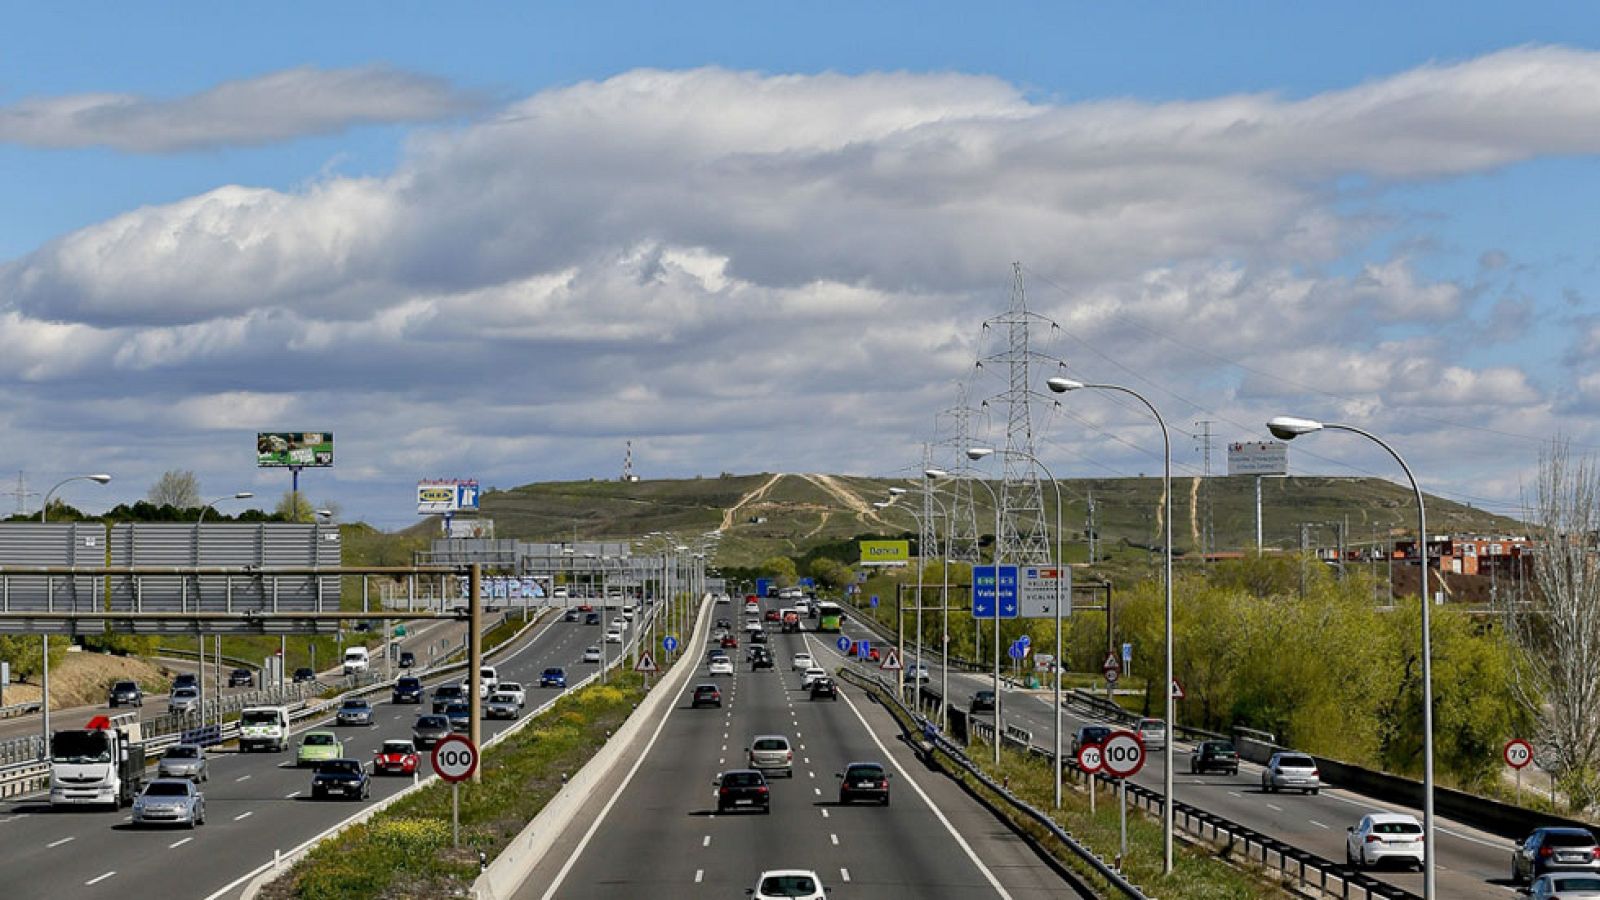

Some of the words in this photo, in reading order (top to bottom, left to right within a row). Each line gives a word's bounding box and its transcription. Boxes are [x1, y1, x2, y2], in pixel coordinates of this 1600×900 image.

[439, 750, 471, 767] 100
[1084, 752, 1100, 763] 70
[1107, 746, 1139, 762] 100
[1510, 749, 1527, 758] 70
